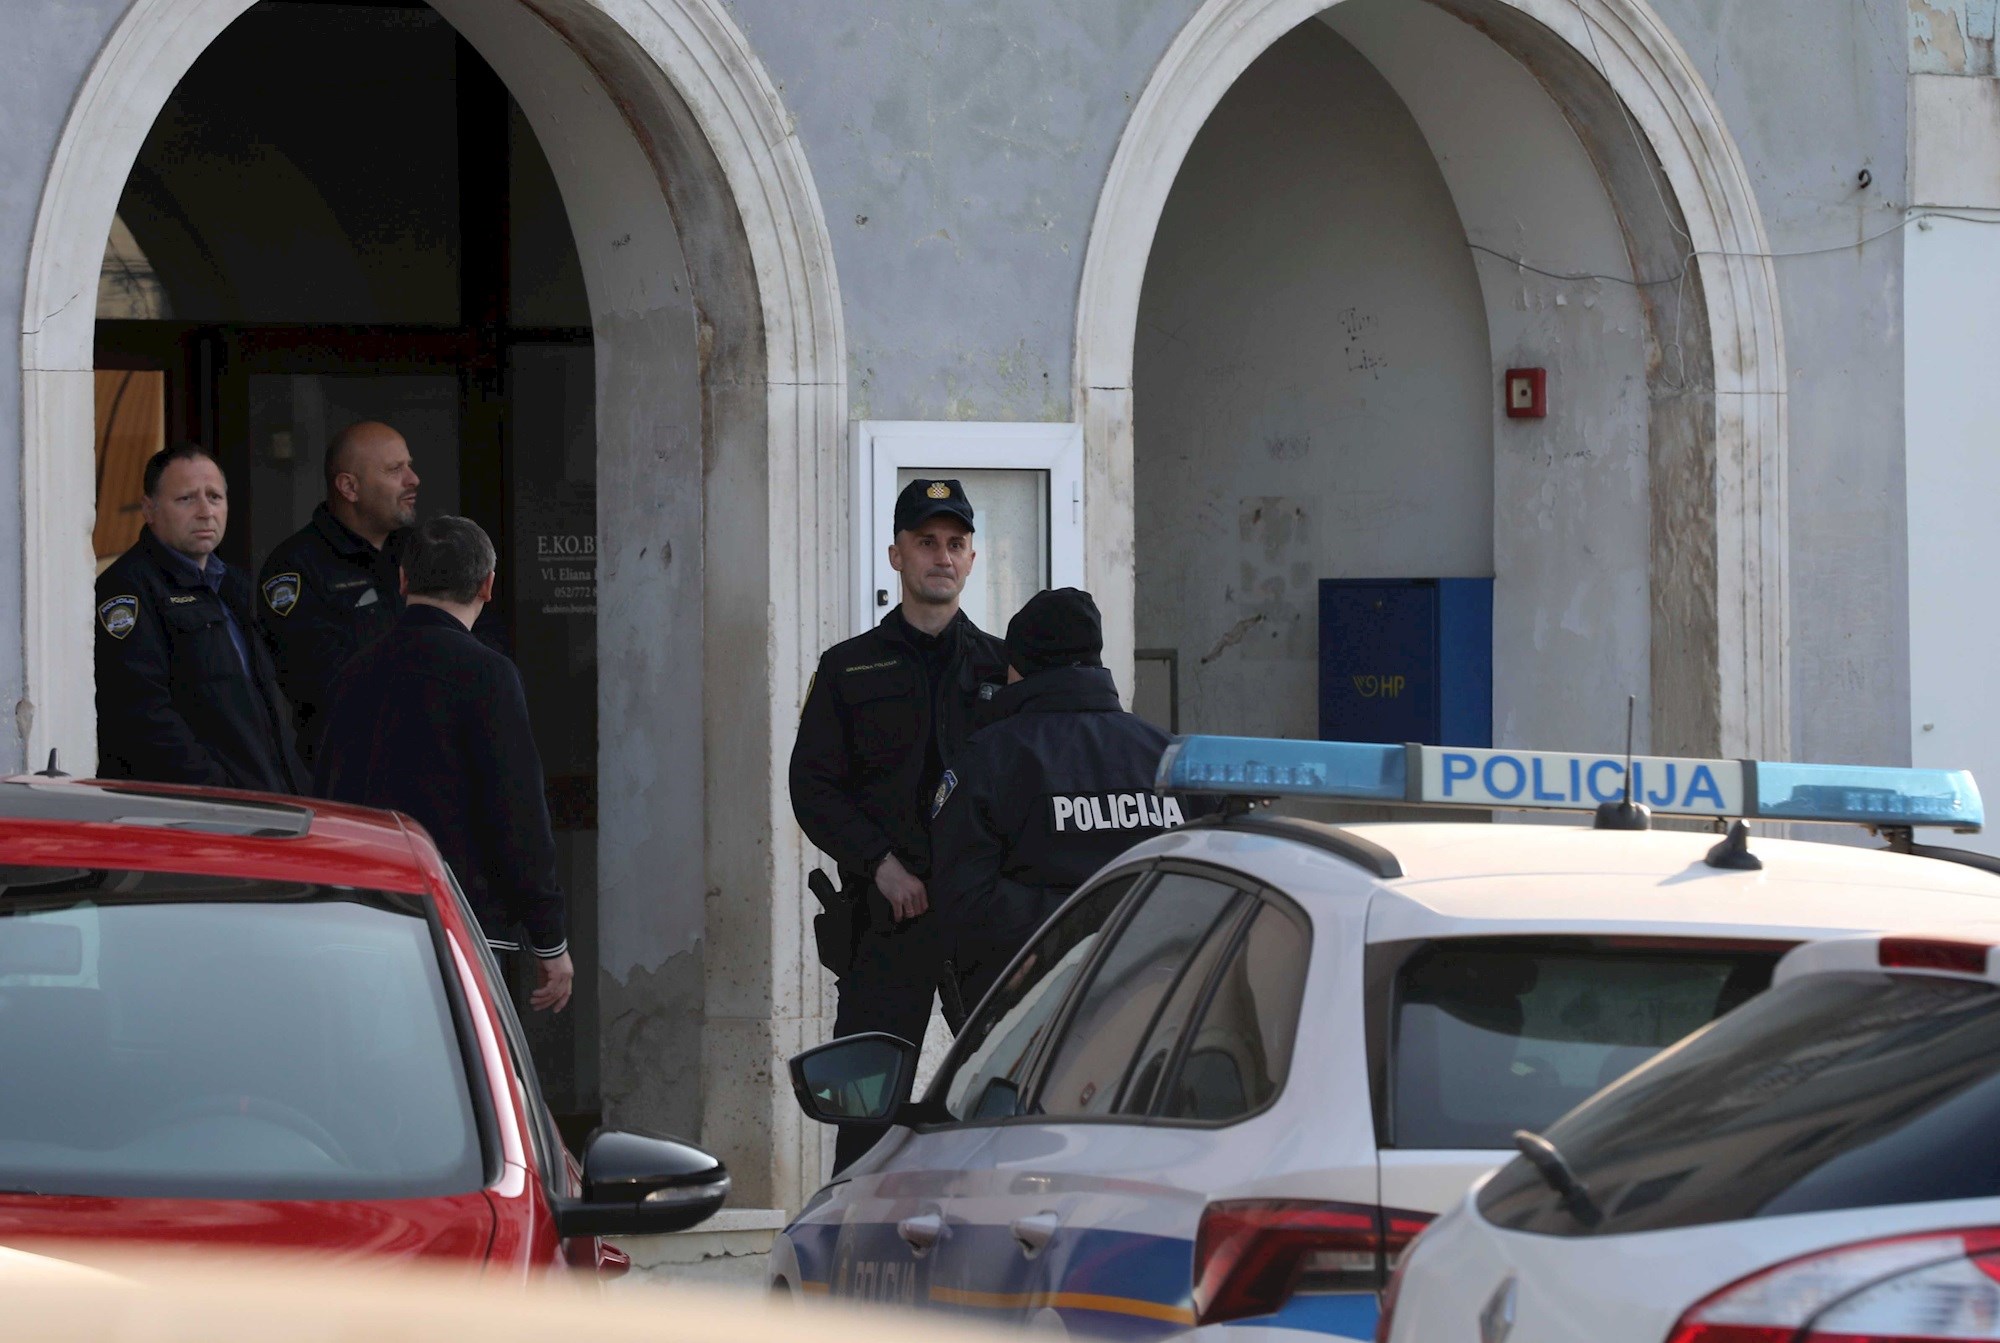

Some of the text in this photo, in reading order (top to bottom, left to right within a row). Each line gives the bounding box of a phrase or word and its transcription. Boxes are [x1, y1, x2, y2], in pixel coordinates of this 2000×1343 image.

[537, 535, 597, 554] E.KO.B
[560, 567, 591, 580] Eliana
[1380, 674, 1406, 698] HP
[1442, 753, 1726, 809] POLICIJA
[1052, 792, 1185, 832] POLICIJA
